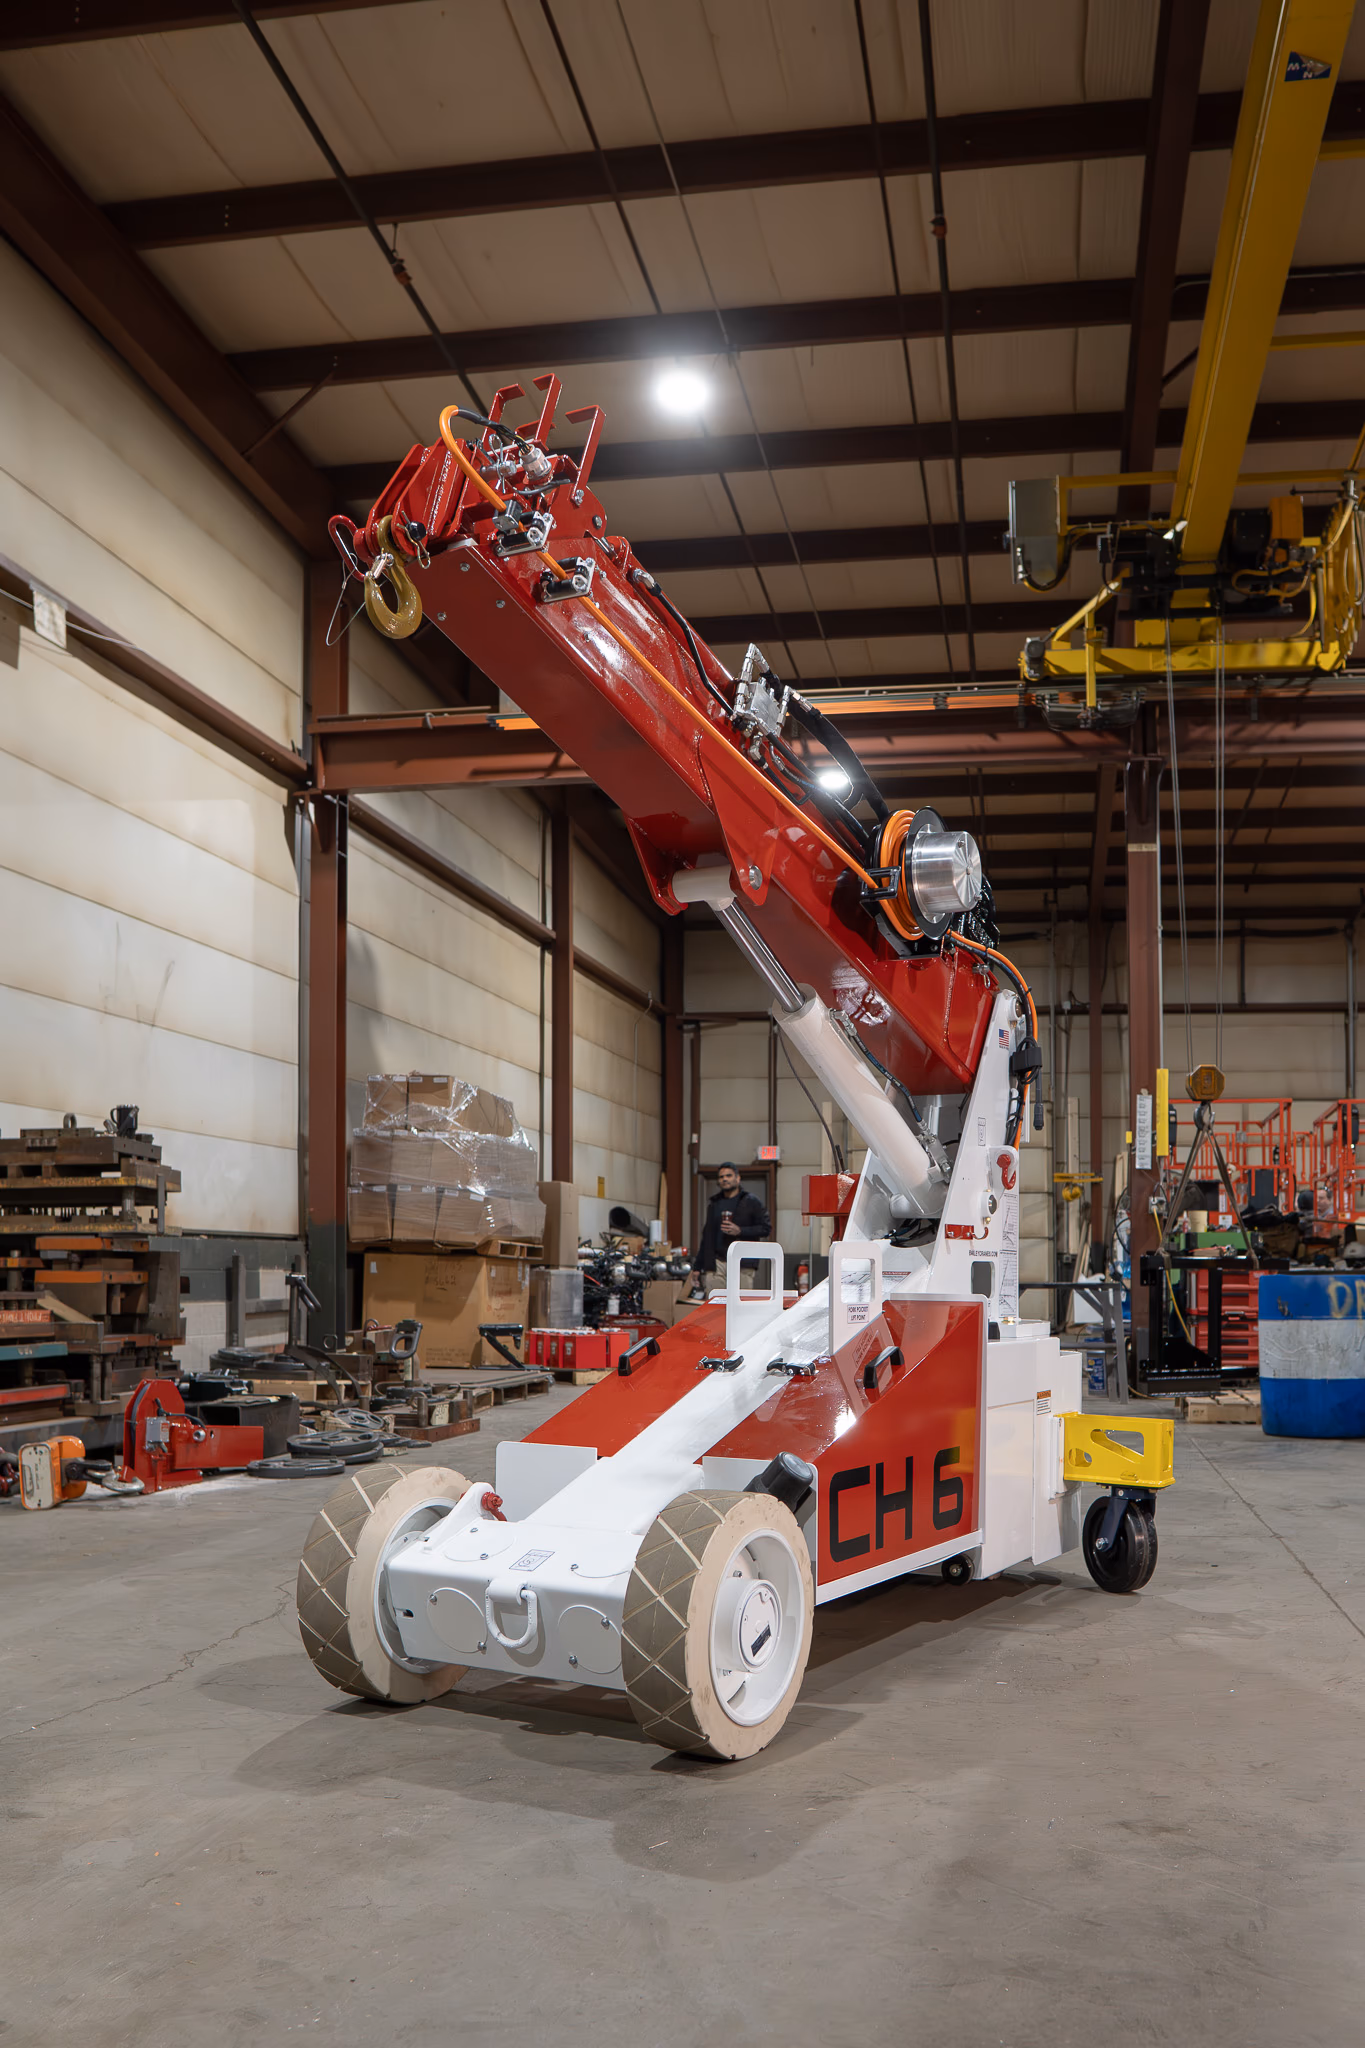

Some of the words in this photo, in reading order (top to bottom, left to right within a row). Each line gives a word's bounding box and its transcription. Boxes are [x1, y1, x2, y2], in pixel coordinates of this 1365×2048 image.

[761, 1145, 777, 1160] EXIT
[829, 1456, 914, 1563] CH
[932, 1445, 964, 1531] 6
